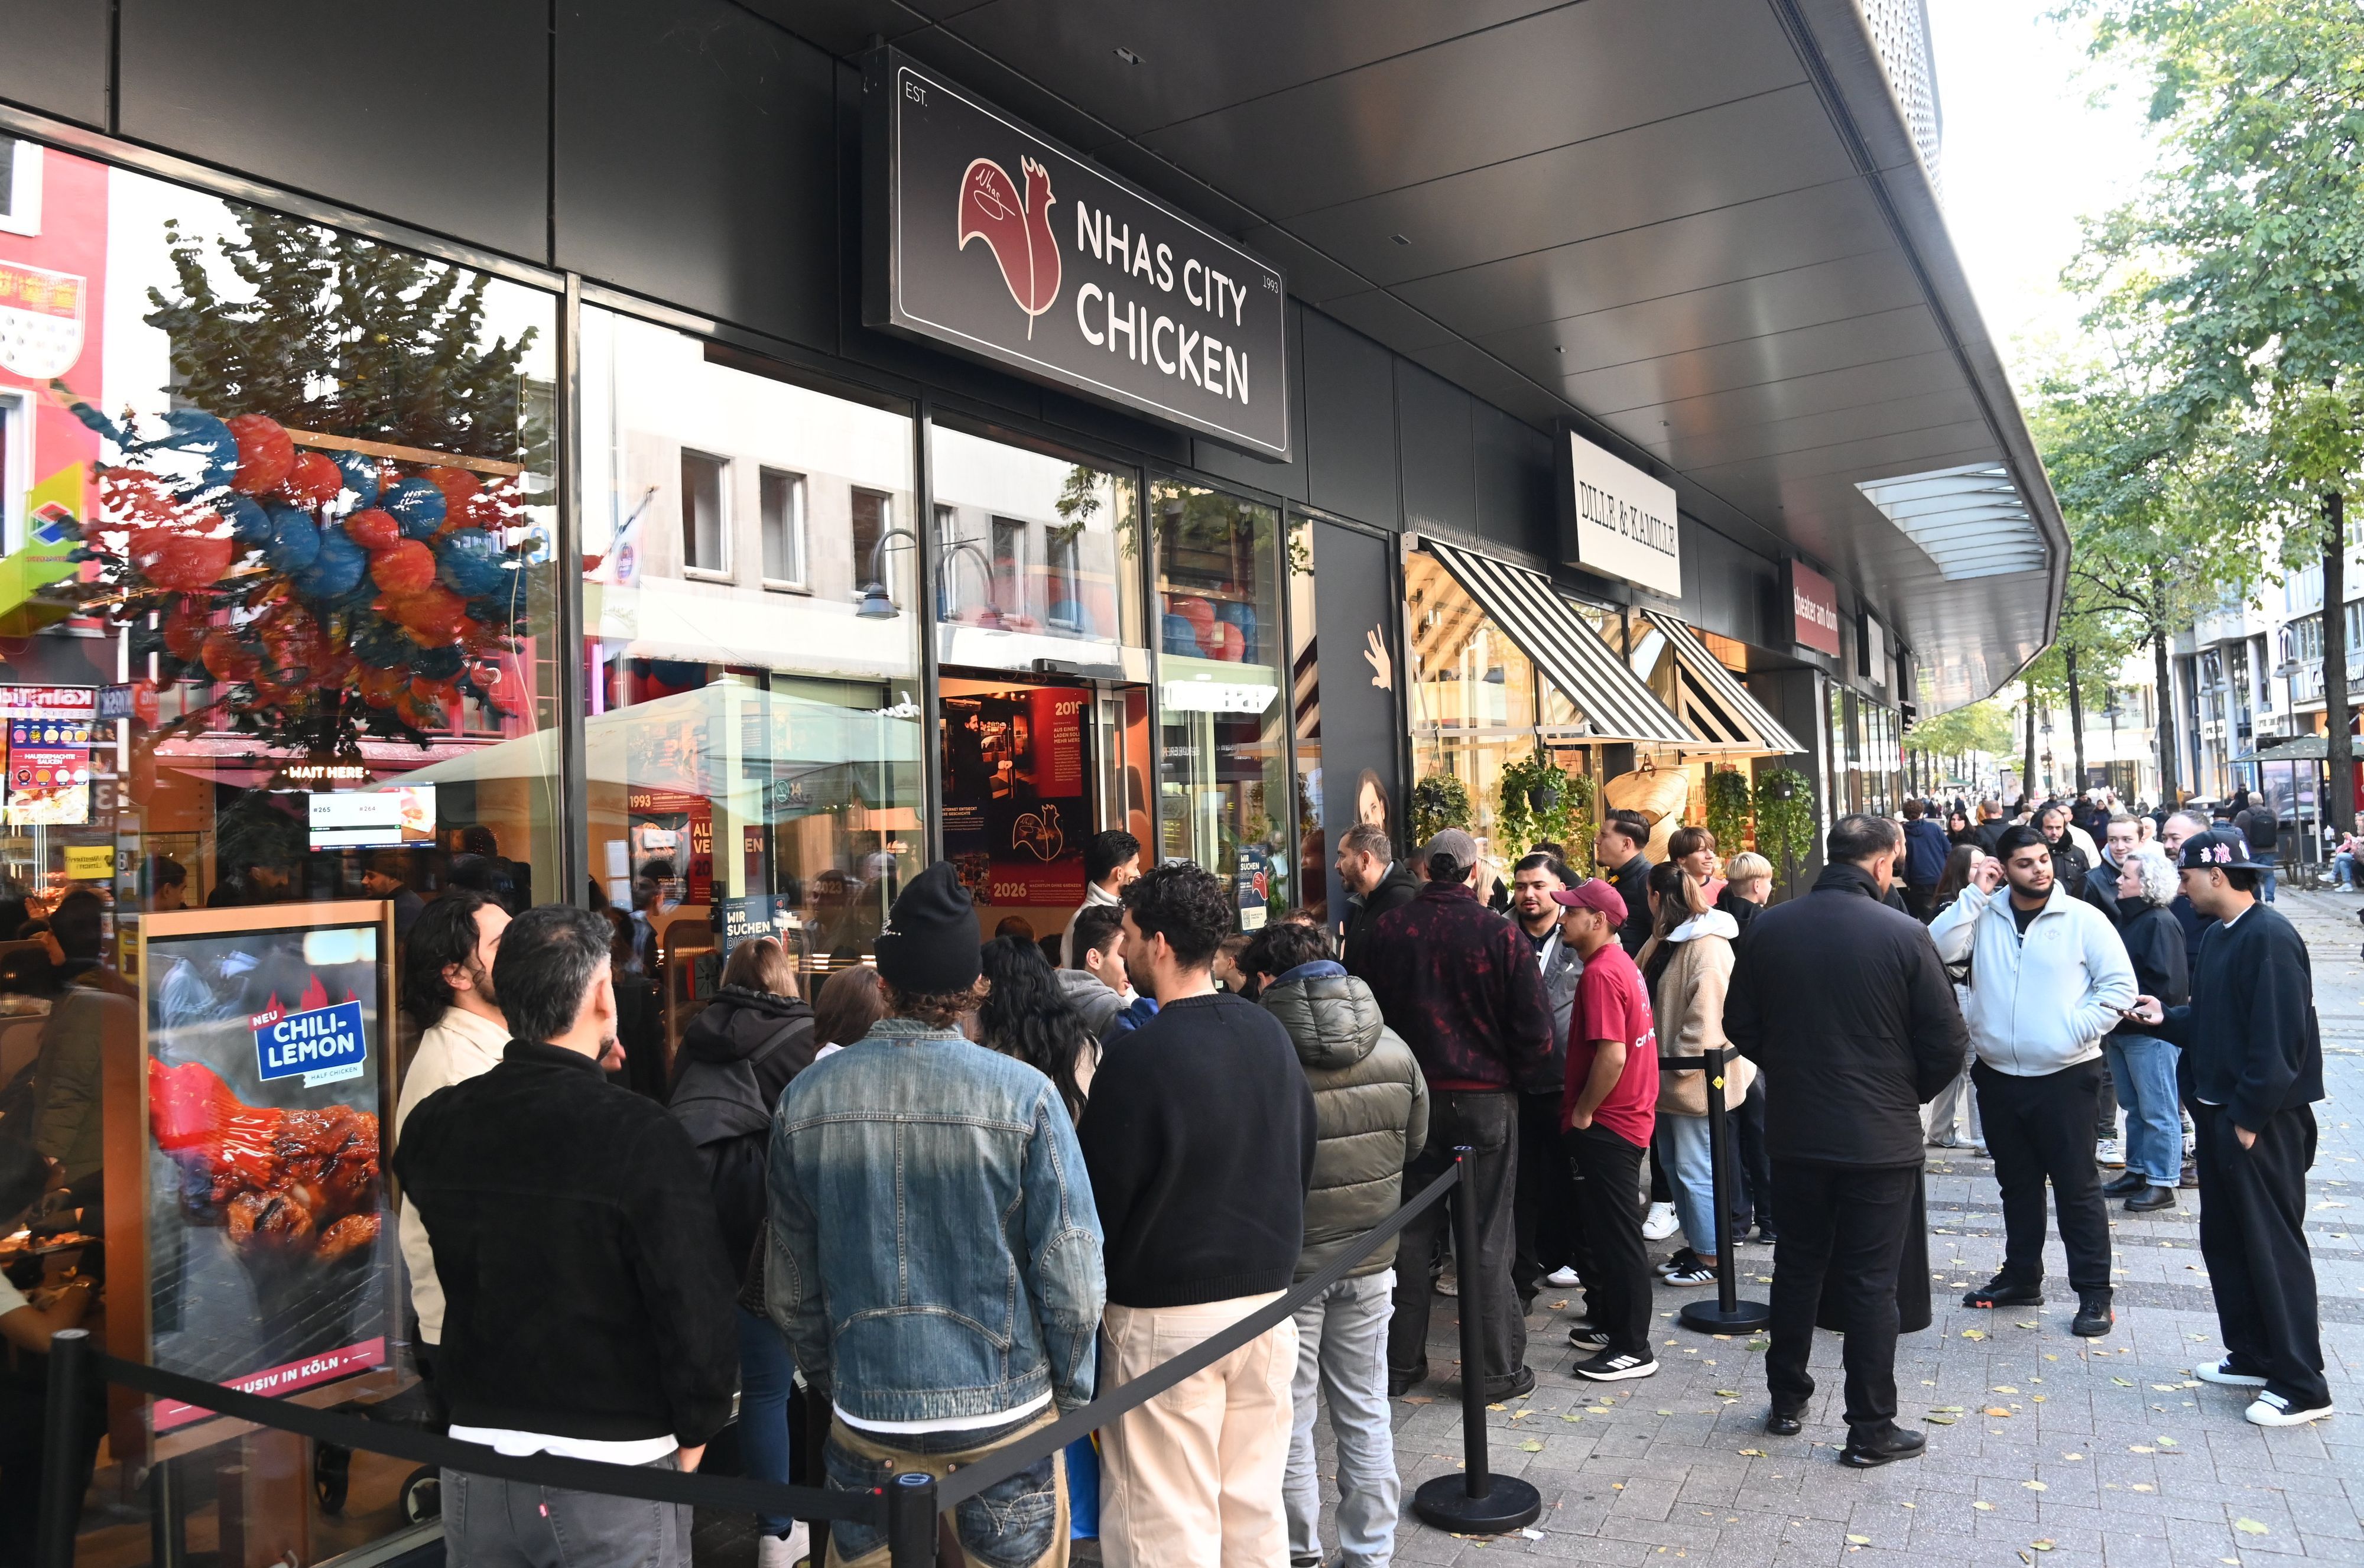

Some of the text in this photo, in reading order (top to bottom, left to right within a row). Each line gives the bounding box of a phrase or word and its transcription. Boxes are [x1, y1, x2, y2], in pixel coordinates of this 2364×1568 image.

[906, 81, 927, 107] EST.
[1077, 200, 1246, 326] NHAS CITY
[1263, 275, 1278, 294] 1993
[1077, 283, 1248, 405] CHICKEN
[1580, 480, 1675, 558] DILLE & KAMILLE
[1794, 586, 1837, 632] theater am dom
[289, 766, 364, 779] WAIT HERE
[629, 795, 651, 809] 1993
[1240, 862, 1259, 871] SUCHEN
[993, 883, 1027, 898] 2026
[727, 911, 745, 924] WIR
[727, 921, 770, 936] SUCHEN
[252, 1010, 278, 1027] NEU
[273, 1012, 347, 1043] CHILI-
[268, 1033, 355, 1068] LEMON
[311, 1066, 358, 1081] HALF CHICKEN
[282, 1369, 297, 1382] IN
[301, 1356, 339, 1377] KÖLN
